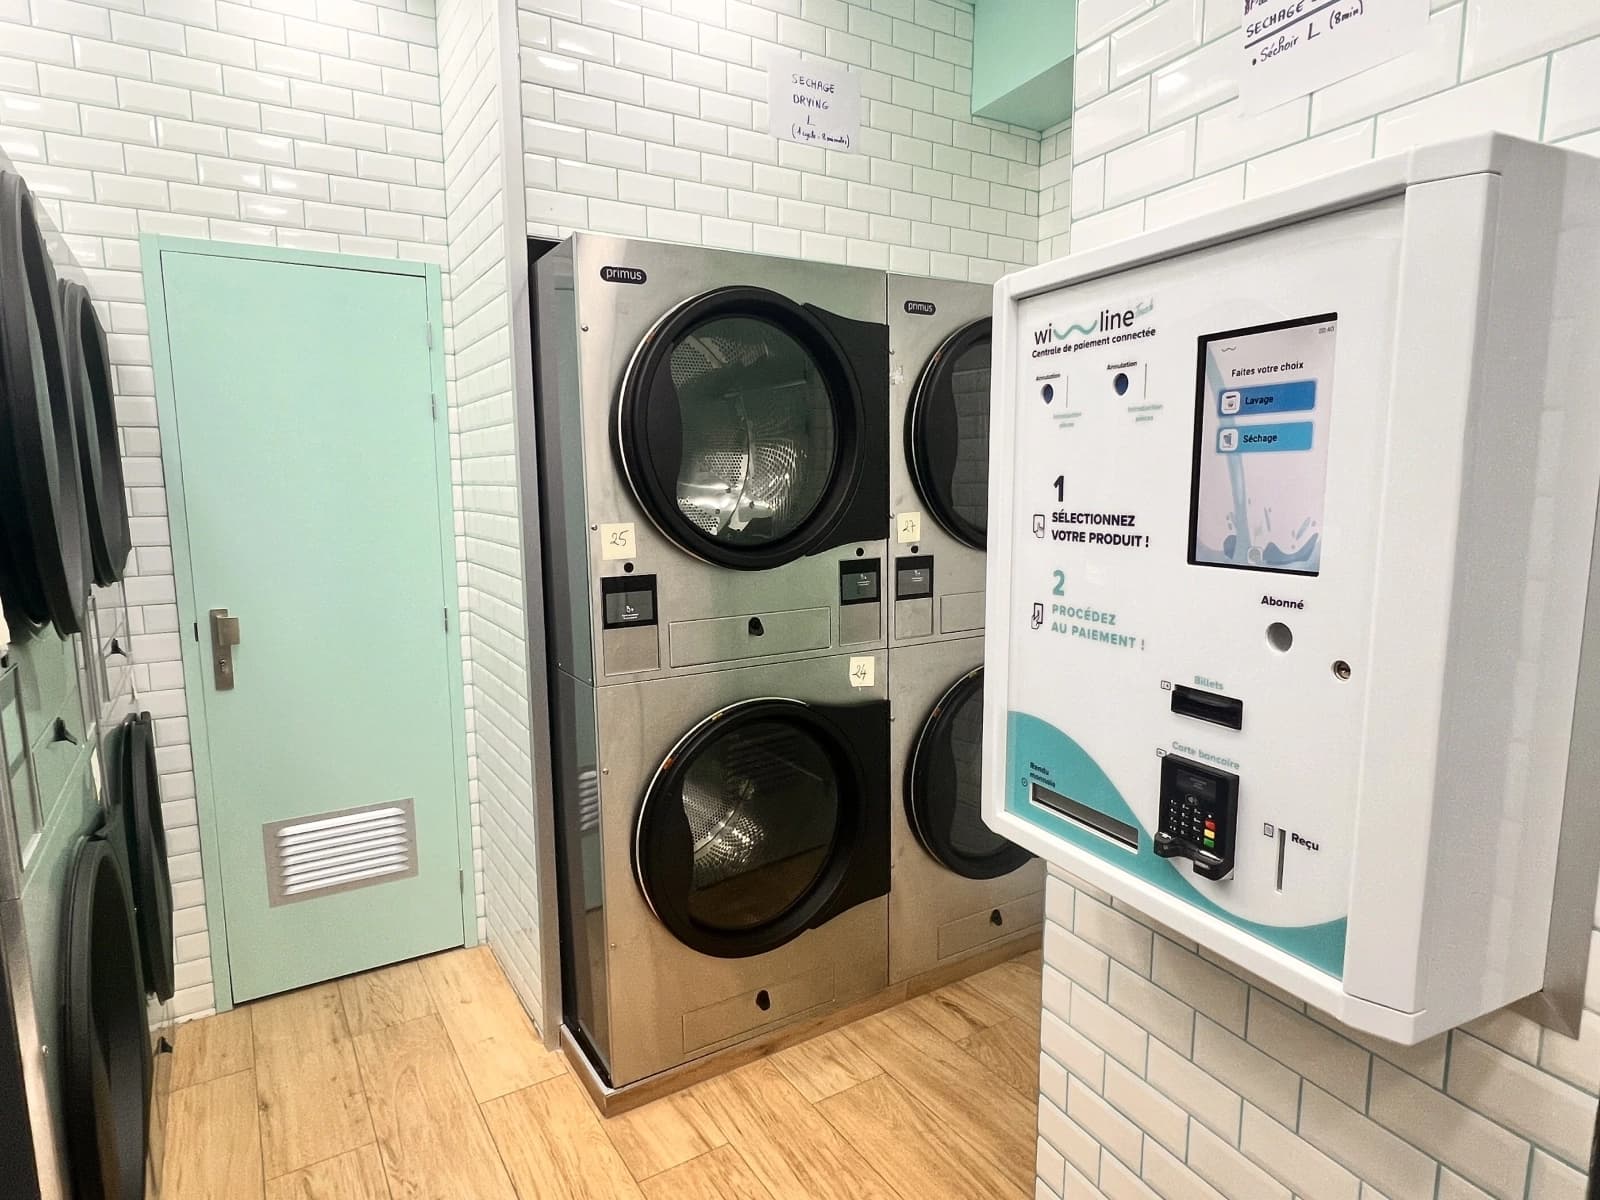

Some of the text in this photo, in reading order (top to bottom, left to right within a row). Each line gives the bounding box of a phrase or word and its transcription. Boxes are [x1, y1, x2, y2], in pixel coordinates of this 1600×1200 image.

[1246, 0, 1304, 38] SECHAGE
[1260, 0, 1364, 62] Séchoir L (8min)
[792, 73, 835, 94] SECHAGE
[793, 94, 829, 110] DRYING
[806, 114, 816, 126] L
[606, 268, 642, 281] primus
[908, 302, 933, 313] primus
[1032, 327, 1156, 358] Centrale de paiement connectée
[1106, 360, 1138, 371] Annulation
[1231, 360, 1305, 378] Faites votre choix
[1244, 394, 1275, 406] Lavage
[1242, 433, 1278, 445] Séchage
[1053, 475, 1065, 502] 1
[1051, 509, 1136, 527] SÉLECTIONNEZ
[609, 529, 631, 547] 25
[1051, 529, 1150, 548] VOTRE PRODUIT !
[1052, 569, 1065, 596] 2
[1260, 595, 1305, 610] Abonné
[1052, 603, 1117, 626] PROCÉDEZ
[1051, 621, 1146, 651] AU PAIEMENT !
[851, 663, 867, 680] 24
[1193, 675, 1225, 691] Billets
[1171, 740, 1241, 771] Carte bancaire
[1291, 832, 1319, 851] Reçu
